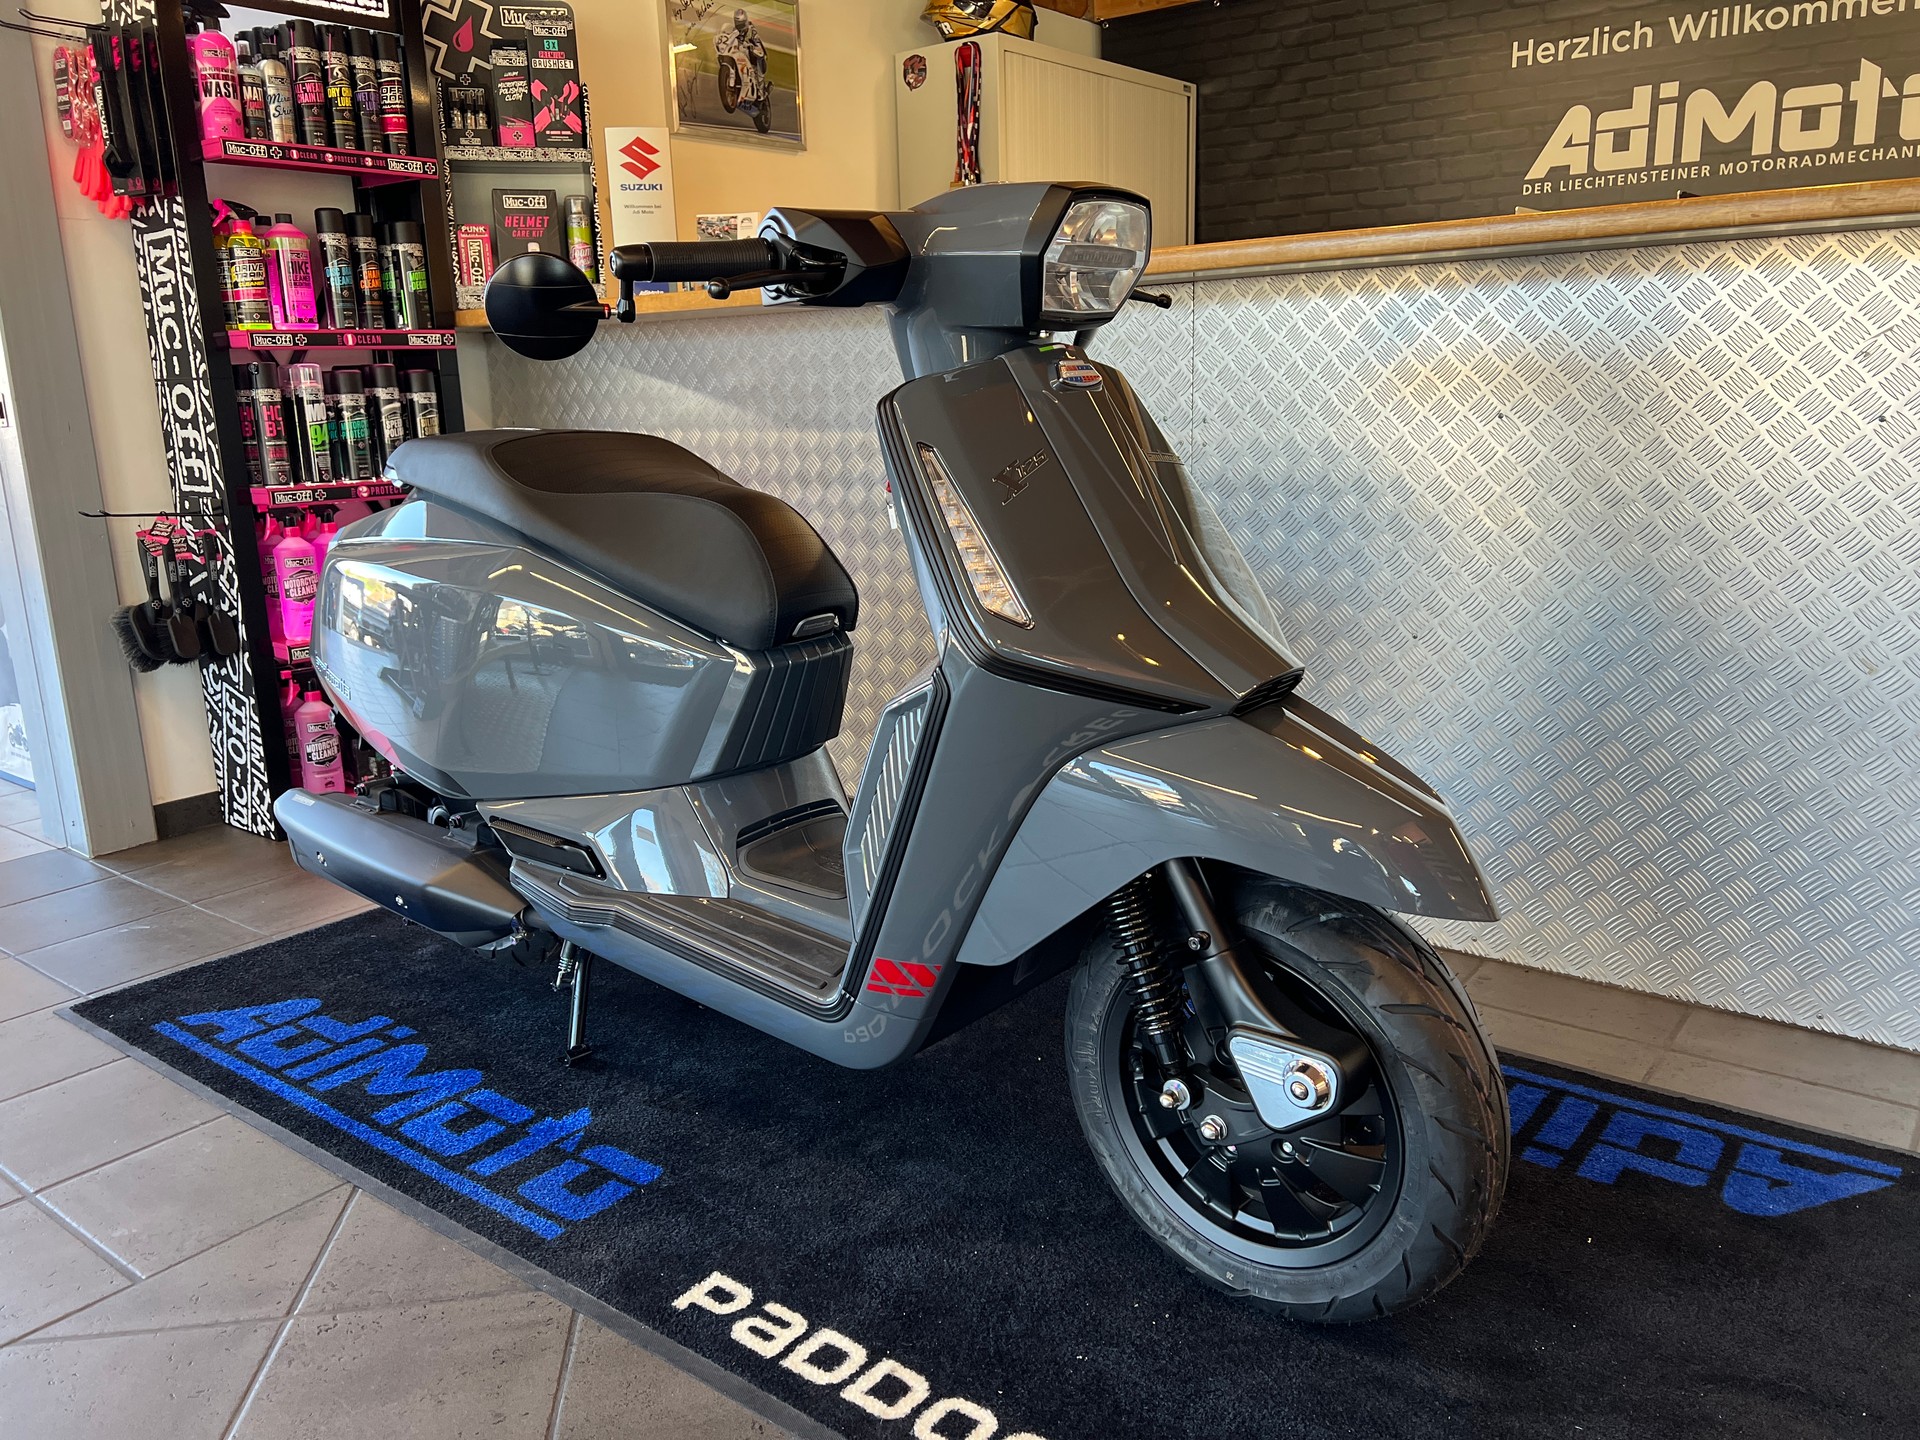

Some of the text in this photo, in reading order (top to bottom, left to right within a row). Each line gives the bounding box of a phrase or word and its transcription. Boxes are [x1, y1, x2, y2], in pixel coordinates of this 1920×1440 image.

[534, 26, 566, 36] Muc-Off
[545, 41, 557, 50] 3X
[1511, 20, 1654, 68] Herzlich
[560, 60, 573, 68] SET
[202, 81, 238, 100] WASH
[505, 94, 523, 102] CLOTH
[227, 143, 267, 157] Muc-Off
[300, 151, 318, 160] CLEAN
[334, 154, 357, 164] PROTECT
[374, 158, 386, 166] LUBE
[389, 160, 422, 172] Muc-Off
[1522, 181, 1553, 196] DER
[1559, 165, 1711, 193] LIECHTENSTEINER
[620, 183, 663, 191] SUZUKI
[505, 196, 546, 208] Muc-Off
[505, 215, 549, 228] HELMET
[461, 225, 485, 233] PUNK
[512, 230, 544, 238] CARE KIT
[235, 263, 264, 272] DRIVE
[470, 242, 485, 286] Muc-Off
[235, 272, 264, 280] TRAIN
[255, 335, 292, 345] Muc-Off
[357, 335, 382, 344] CLEAN
[409, 335, 441, 345] Muc-Off
[148, 242, 208, 483] Muc-Off
[310, 424, 329, 446] 94
[371, 484, 402, 496] PROTECT
[276, 491, 312, 502] Muc-Off
[286, 557, 314, 567] Muc-Off
[311, 746, 338, 761] CLEANER
[178, 998, 663, 1222] AdiMoto
[1508, 1082, 1897, 1217] Adi
